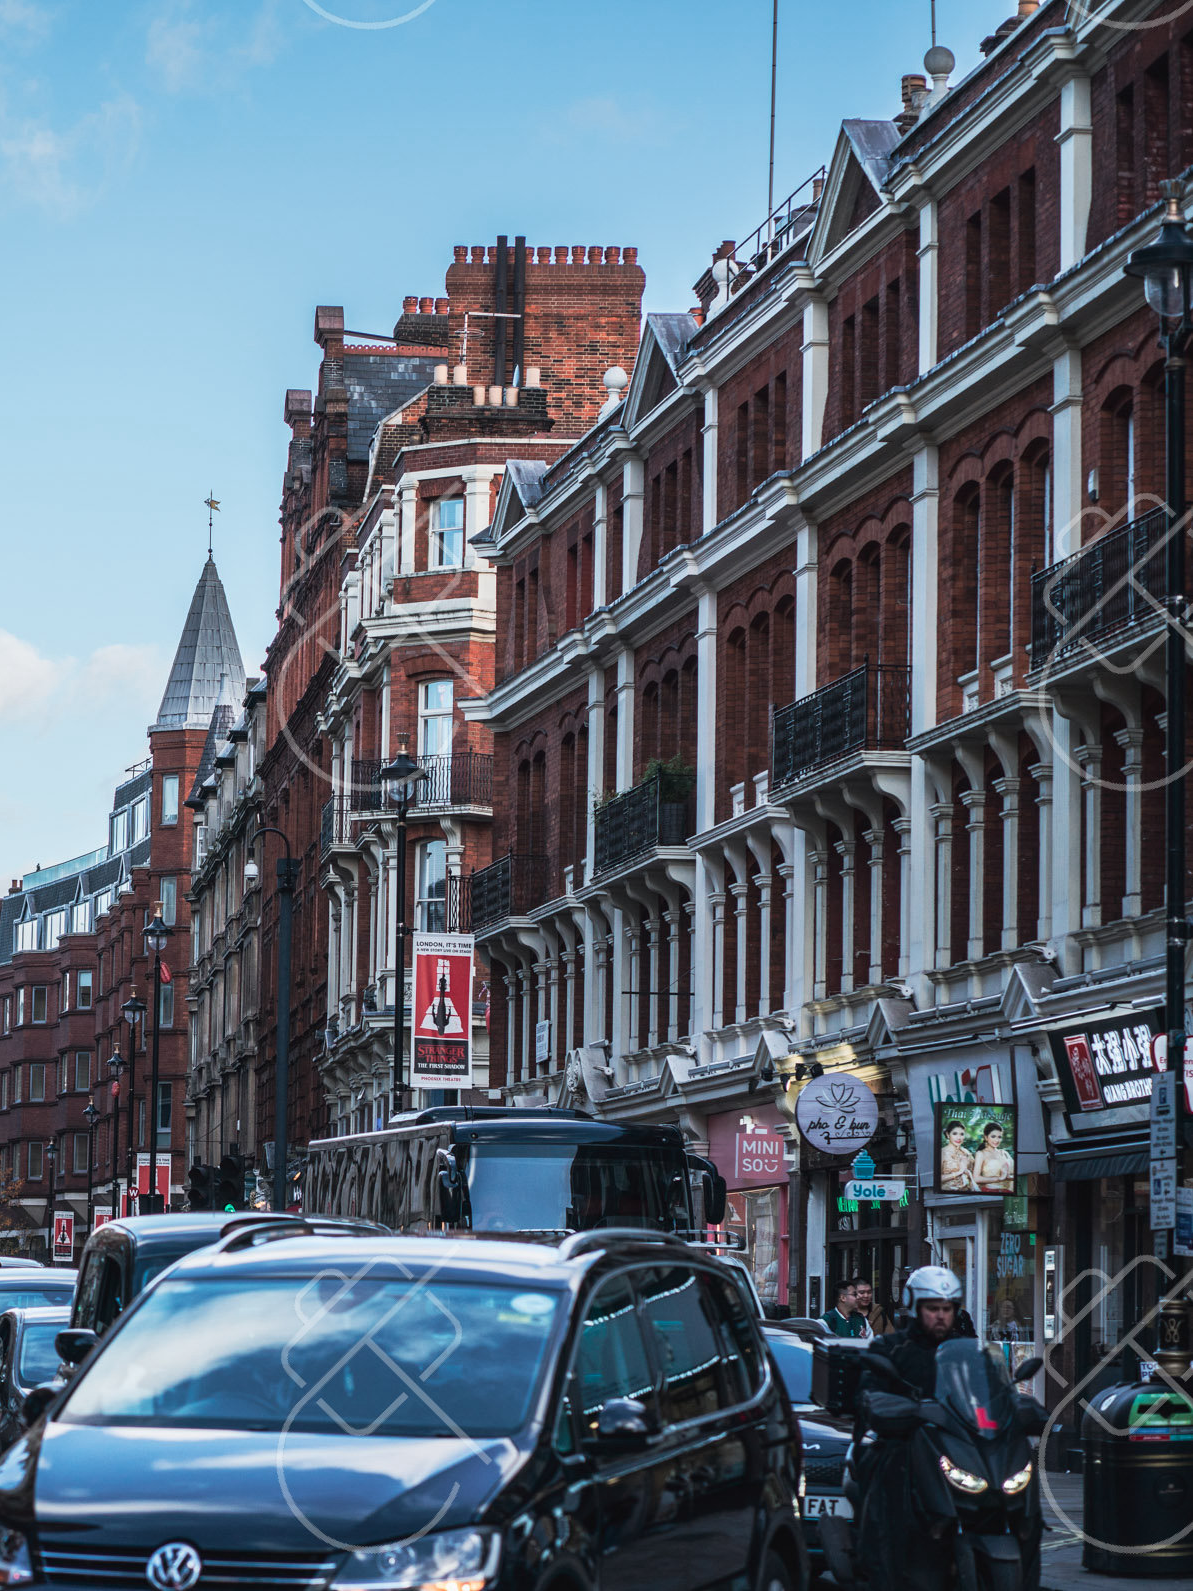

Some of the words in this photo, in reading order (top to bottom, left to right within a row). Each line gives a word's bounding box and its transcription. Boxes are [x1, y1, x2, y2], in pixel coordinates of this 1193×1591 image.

[418, 1046, 464, 1057] STRANGER
[426, 1055, 458, 1063] THINGS
[807, 1117, 830, 1133] pho
[834, 1116, 847, 1129] &
[848, 1117, 870, 1132] bun
[742, 1140, 779, 1155] MINI
[1000, 1232, 1021, 1255] ZERO
[996, 1254, 1024, 1278] SUGAR
[975, 1407, 998, 1429] L
